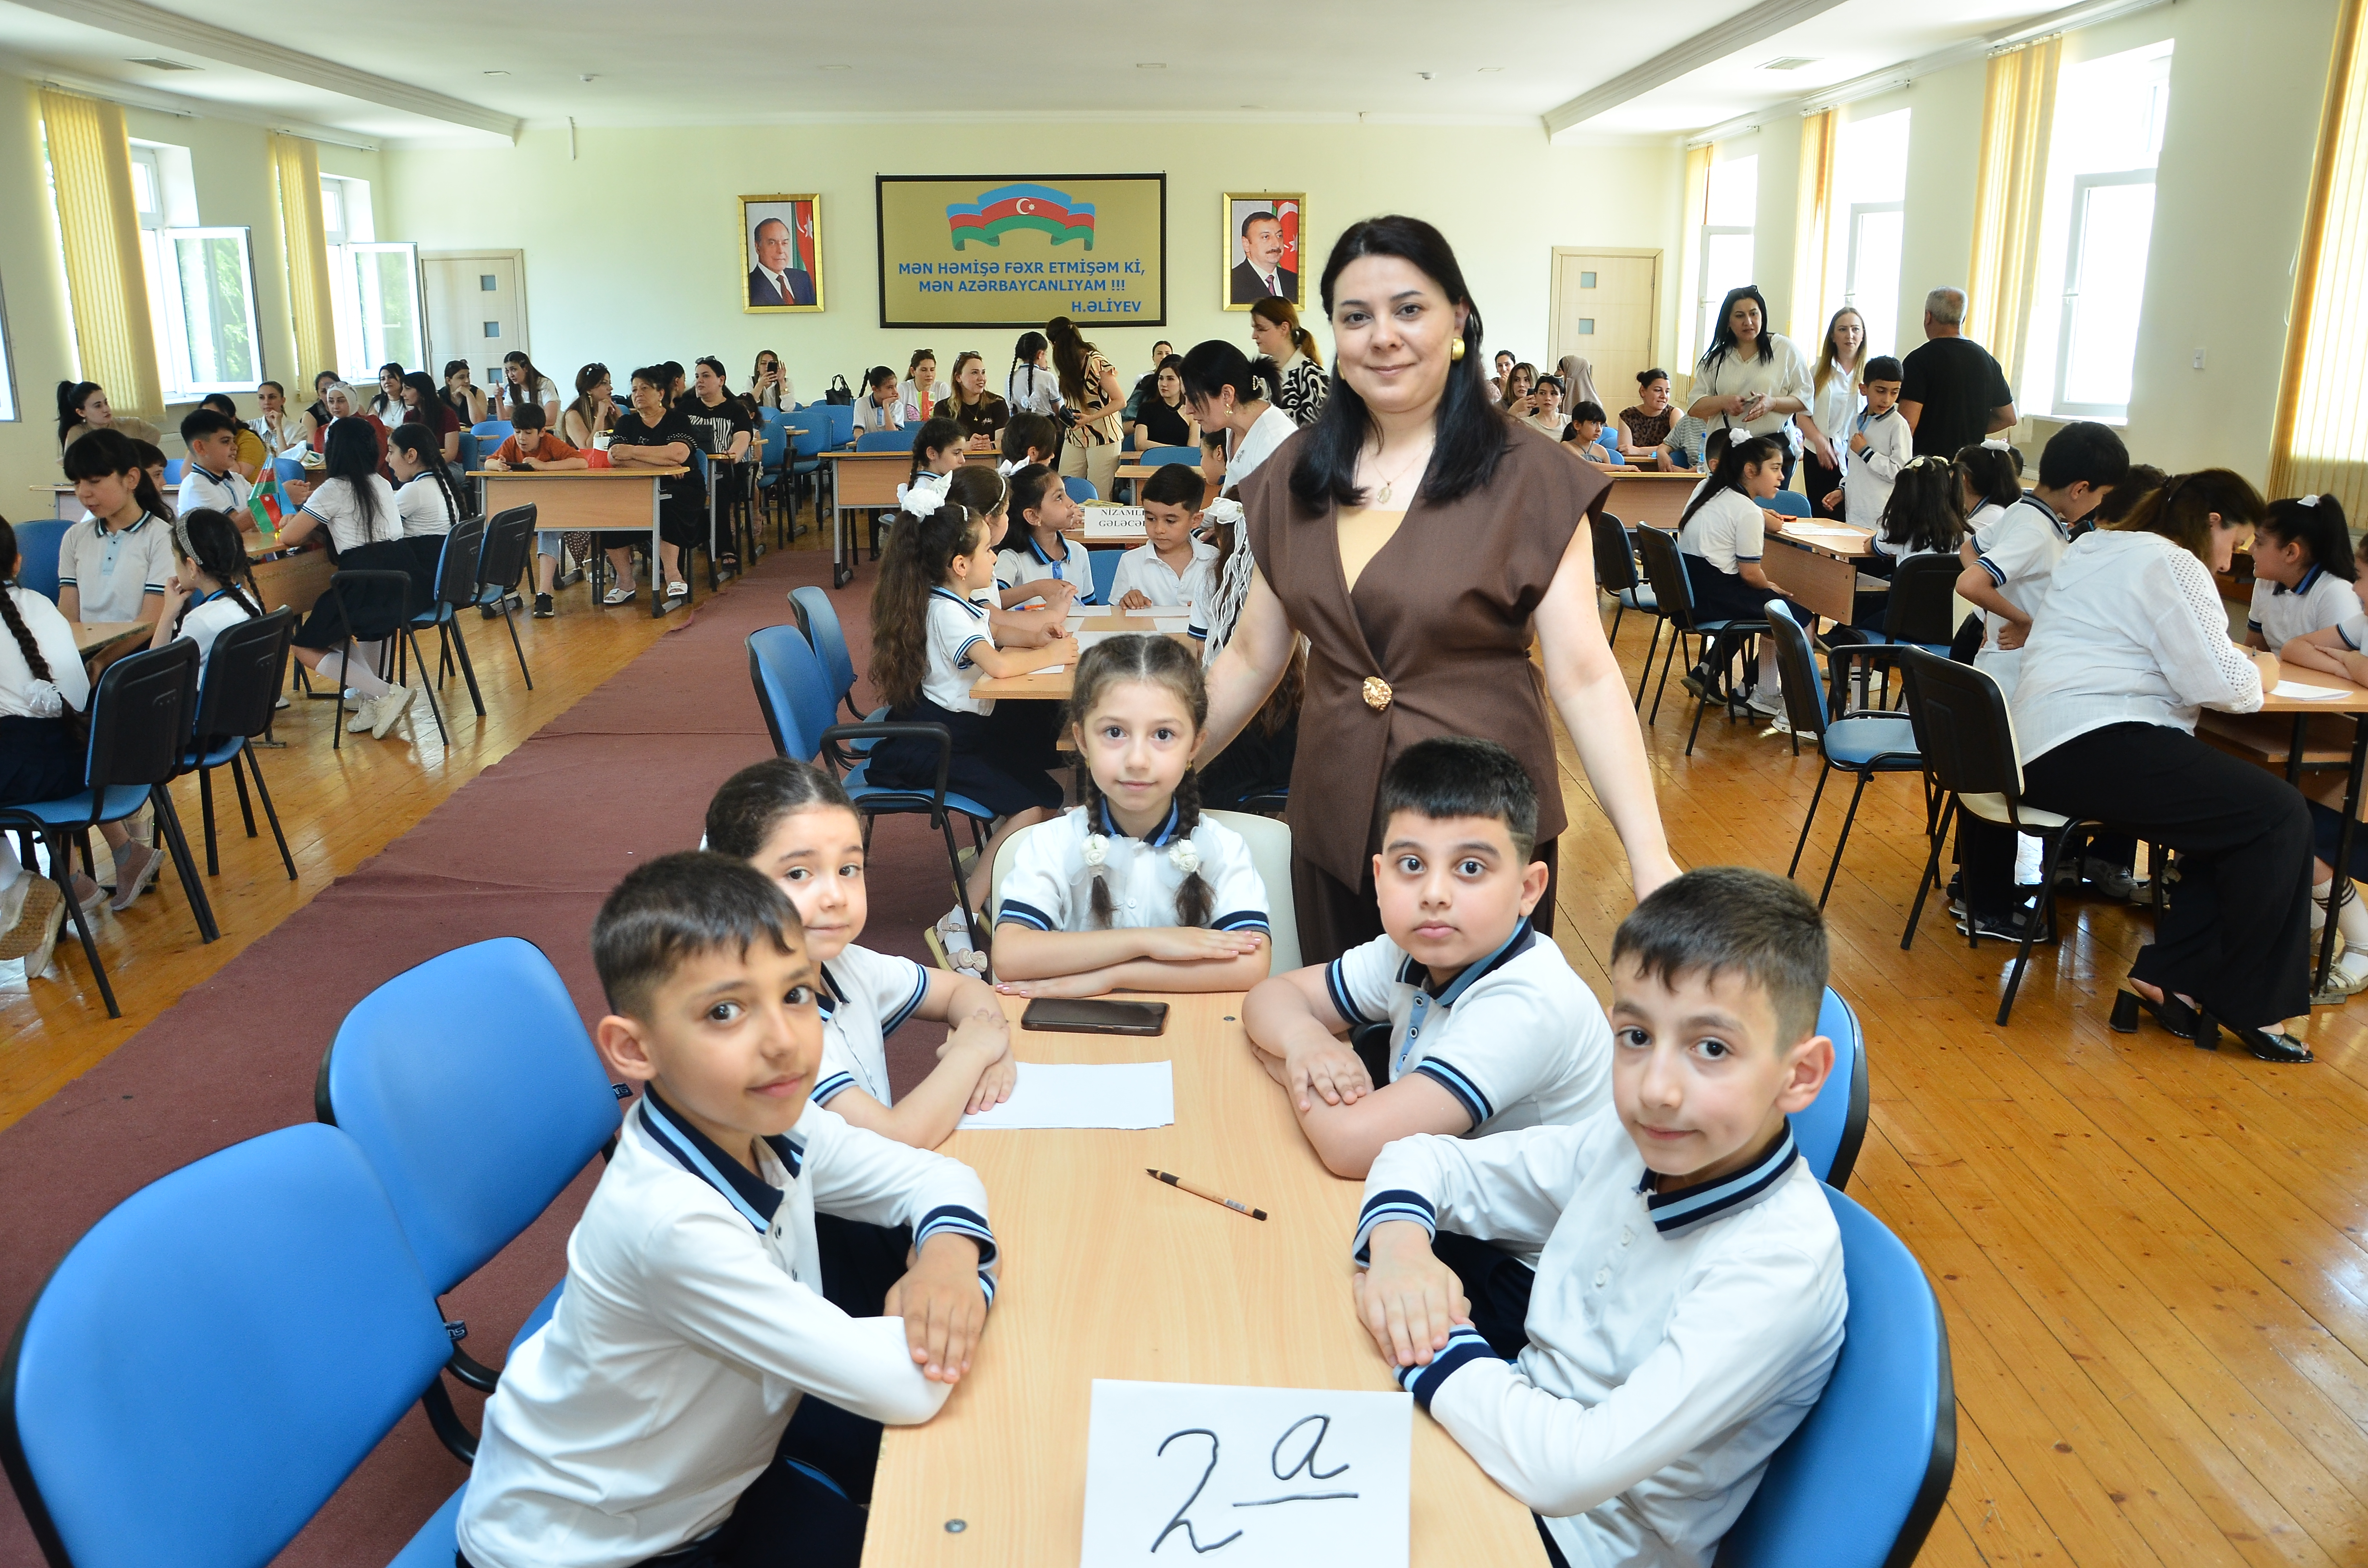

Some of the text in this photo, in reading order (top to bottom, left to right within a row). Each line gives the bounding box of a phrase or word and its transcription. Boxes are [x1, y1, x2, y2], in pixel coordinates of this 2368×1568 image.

[899, 258, 1145, 277] MƏN HƏMİŞƏ FƏXR ETMİŞƏM Kİ,
[919, 280, 1125, 292] MƏN AZƏRBAYCANLIYAM !!!
[1072, 298, 1141, 312] H.ƏLİYEV
